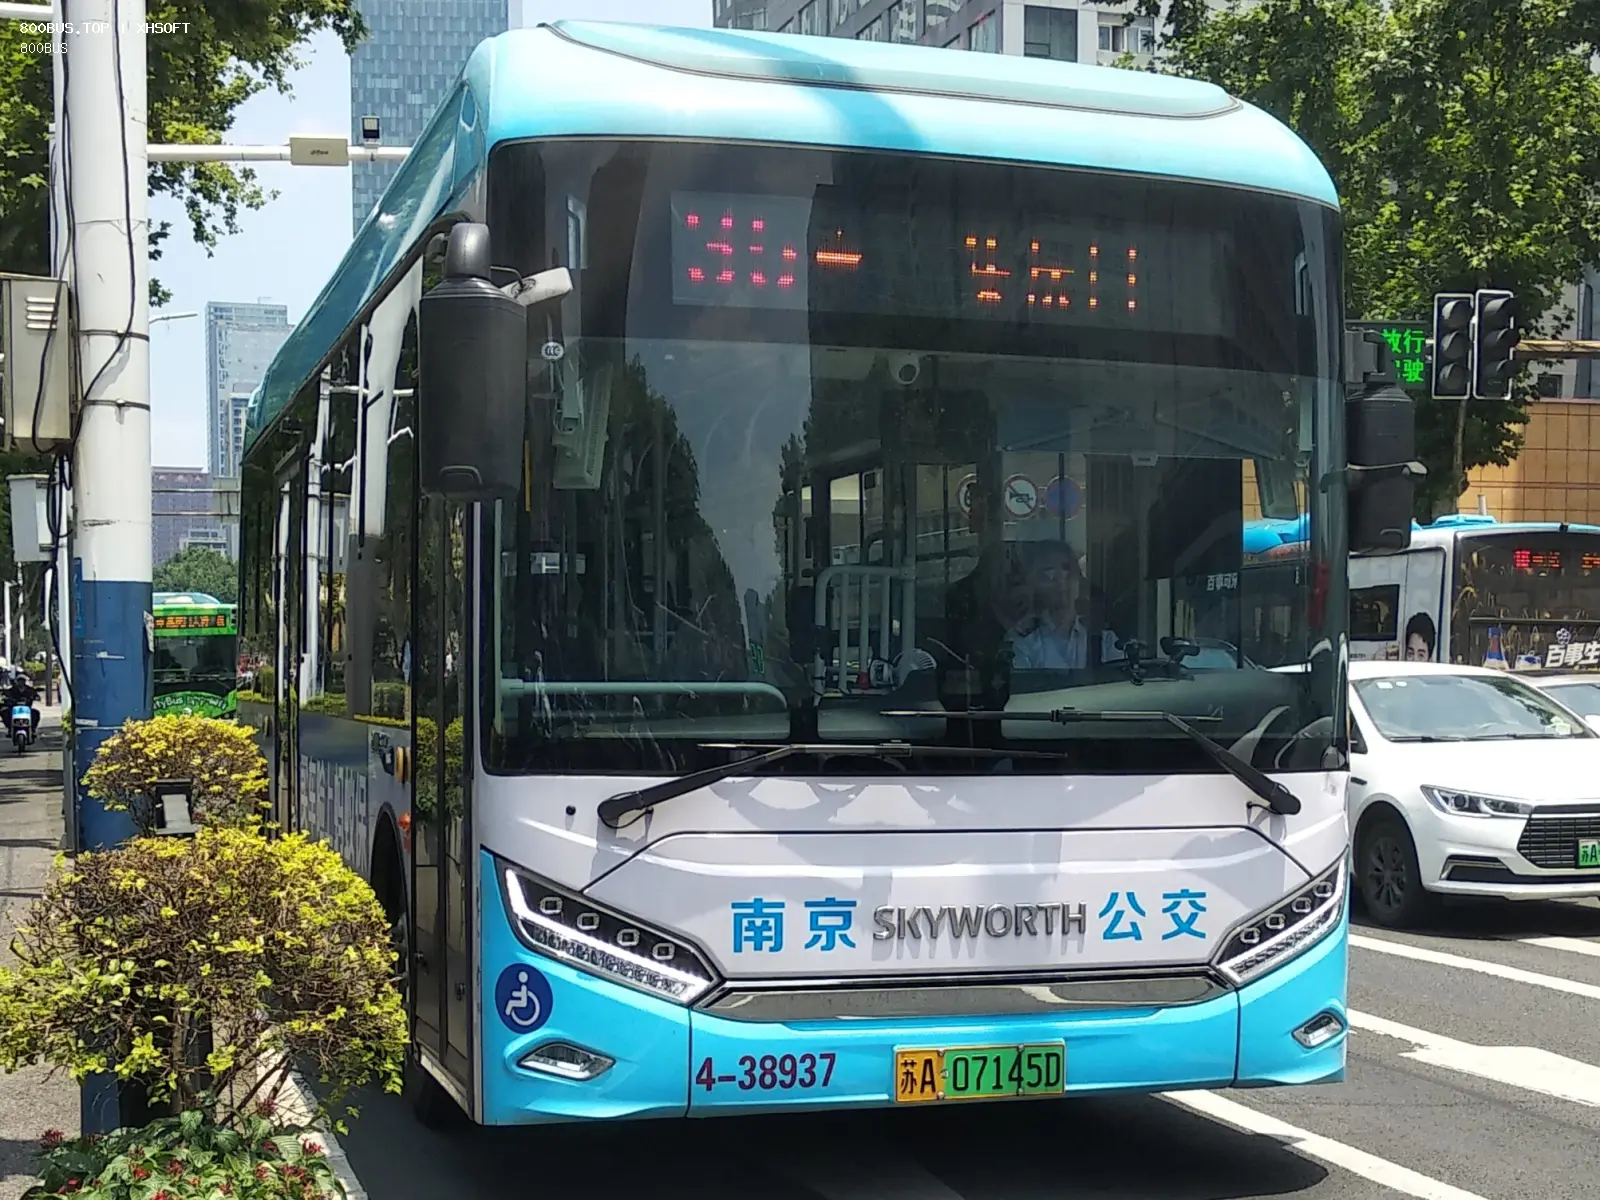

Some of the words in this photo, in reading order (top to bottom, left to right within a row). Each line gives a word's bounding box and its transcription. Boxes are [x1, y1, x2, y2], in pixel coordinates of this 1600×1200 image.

[1395, 358, 1424, 382] 驶
[731, 897, 857, 953] 南京
[872, 901, 1087, 940] SKYWORTH
[1098, 888, 1207, 941] 公交
[695, 1052, 836, 1092] 4-38937
